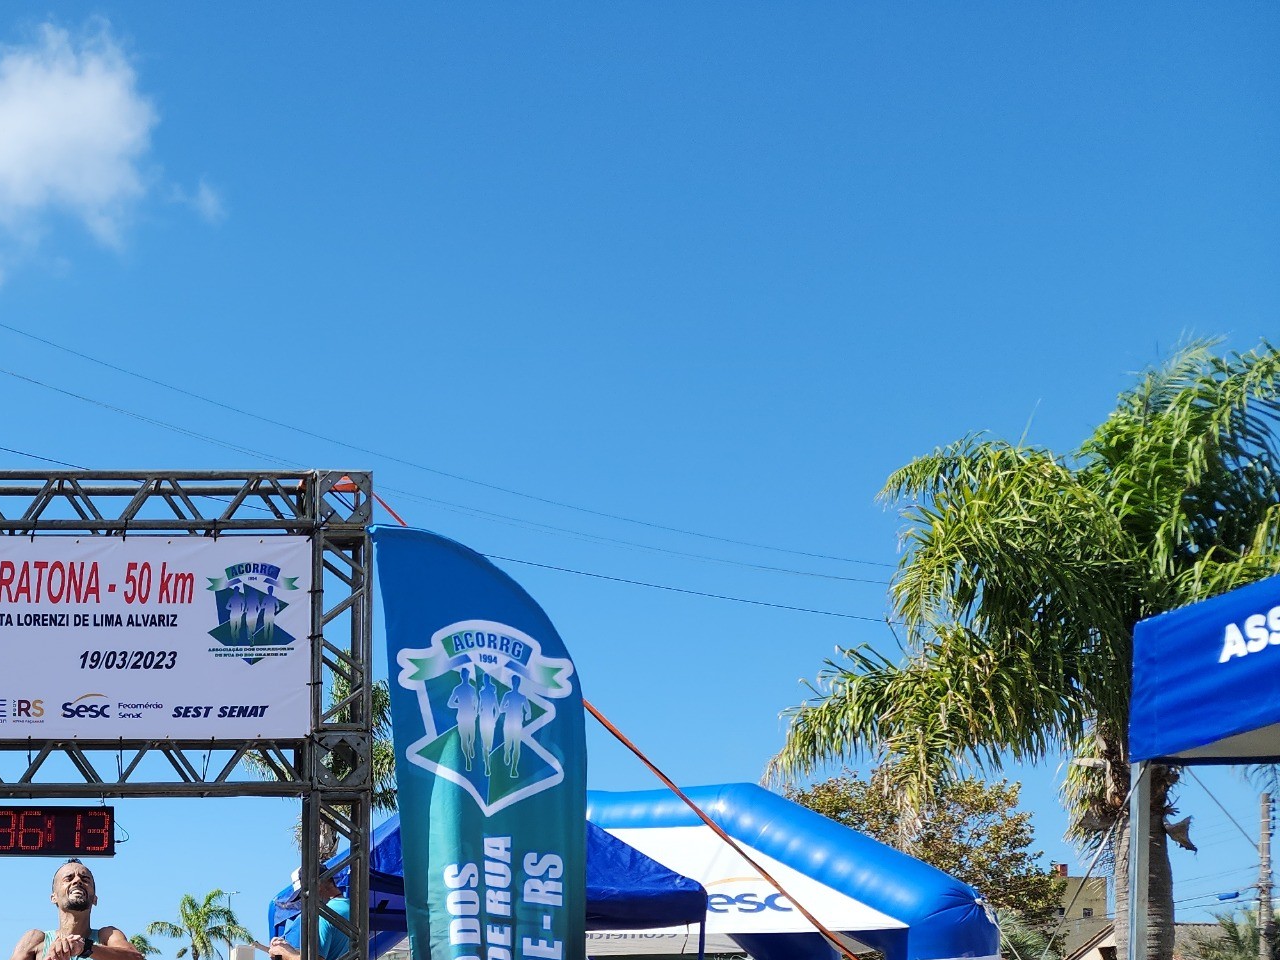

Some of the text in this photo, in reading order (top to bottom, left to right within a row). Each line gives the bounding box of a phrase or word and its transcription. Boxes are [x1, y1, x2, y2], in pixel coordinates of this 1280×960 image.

[108, 583, 117, 593] -
[123, 561, 152, 604] 50
[158, 561, 195, 604] km
[17, 613, 70, 627] LORENZI
[73, 613, 90, 627] DE
[93, 613, 123, 627] LIMA
[126, 613, 178, 627] ALVARIZ
[452, 631, 523, 658] ACORRG
[79, 650, 178, 670] 19/03/2023
[479, 653, 498, 665] 1994
[17, 699, 45, 718] RS
[61, 701, 110, 719] Sesc
[118, 701, 163, 709] Fecomércio
[172, 704, 269, 718] SEST SENAT
[118, 711, 143, 719] Senac
[483, 836, 512, 917] RUA
[523, 852, 564, 907] RS
[443, 862, 482, 945] DOS
[707, 893, 793, 914] esc
